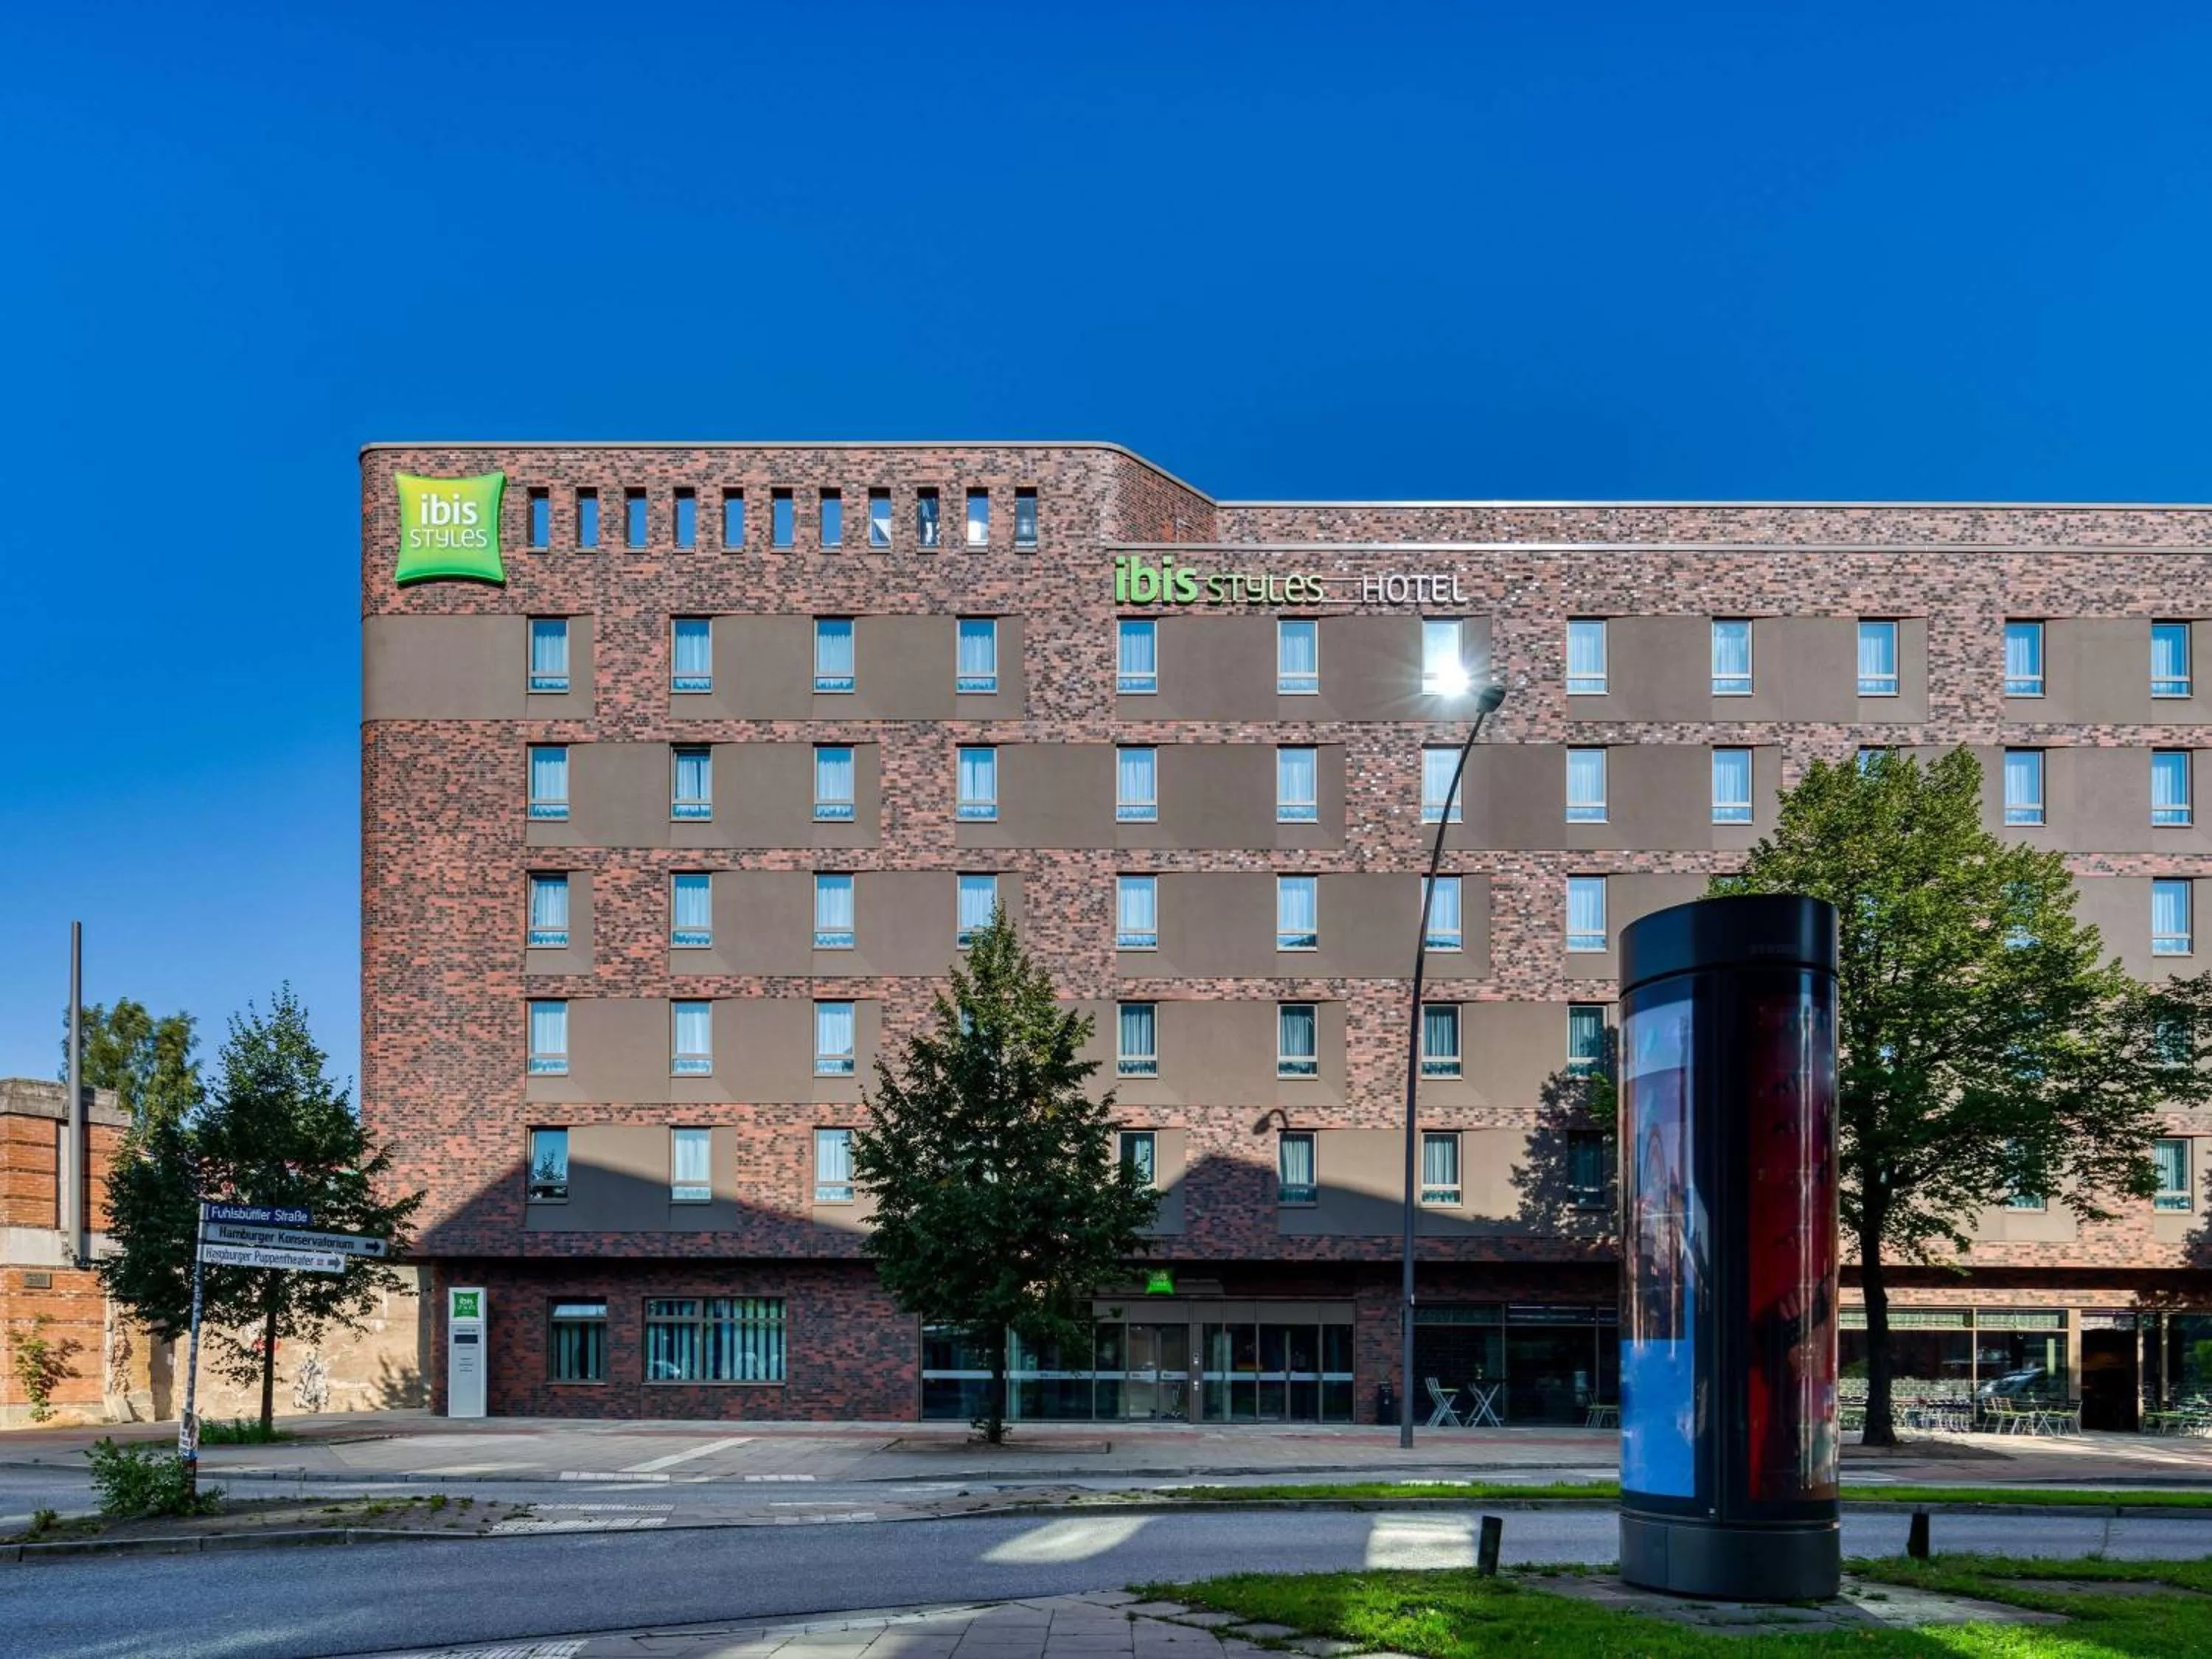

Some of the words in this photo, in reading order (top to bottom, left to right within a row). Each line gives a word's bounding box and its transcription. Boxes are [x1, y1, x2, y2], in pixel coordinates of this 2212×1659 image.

[420, 493, 479, 526] ibis
[1114, 555, 1198, 605] ibis
[1363, 574, 1470, 603] HOTEL
[274, 1209, 308, 1222] Straße
[219, 1225, 275, 1244] Hamburger
[278, 1232, 355, 1250] Konservatorium
